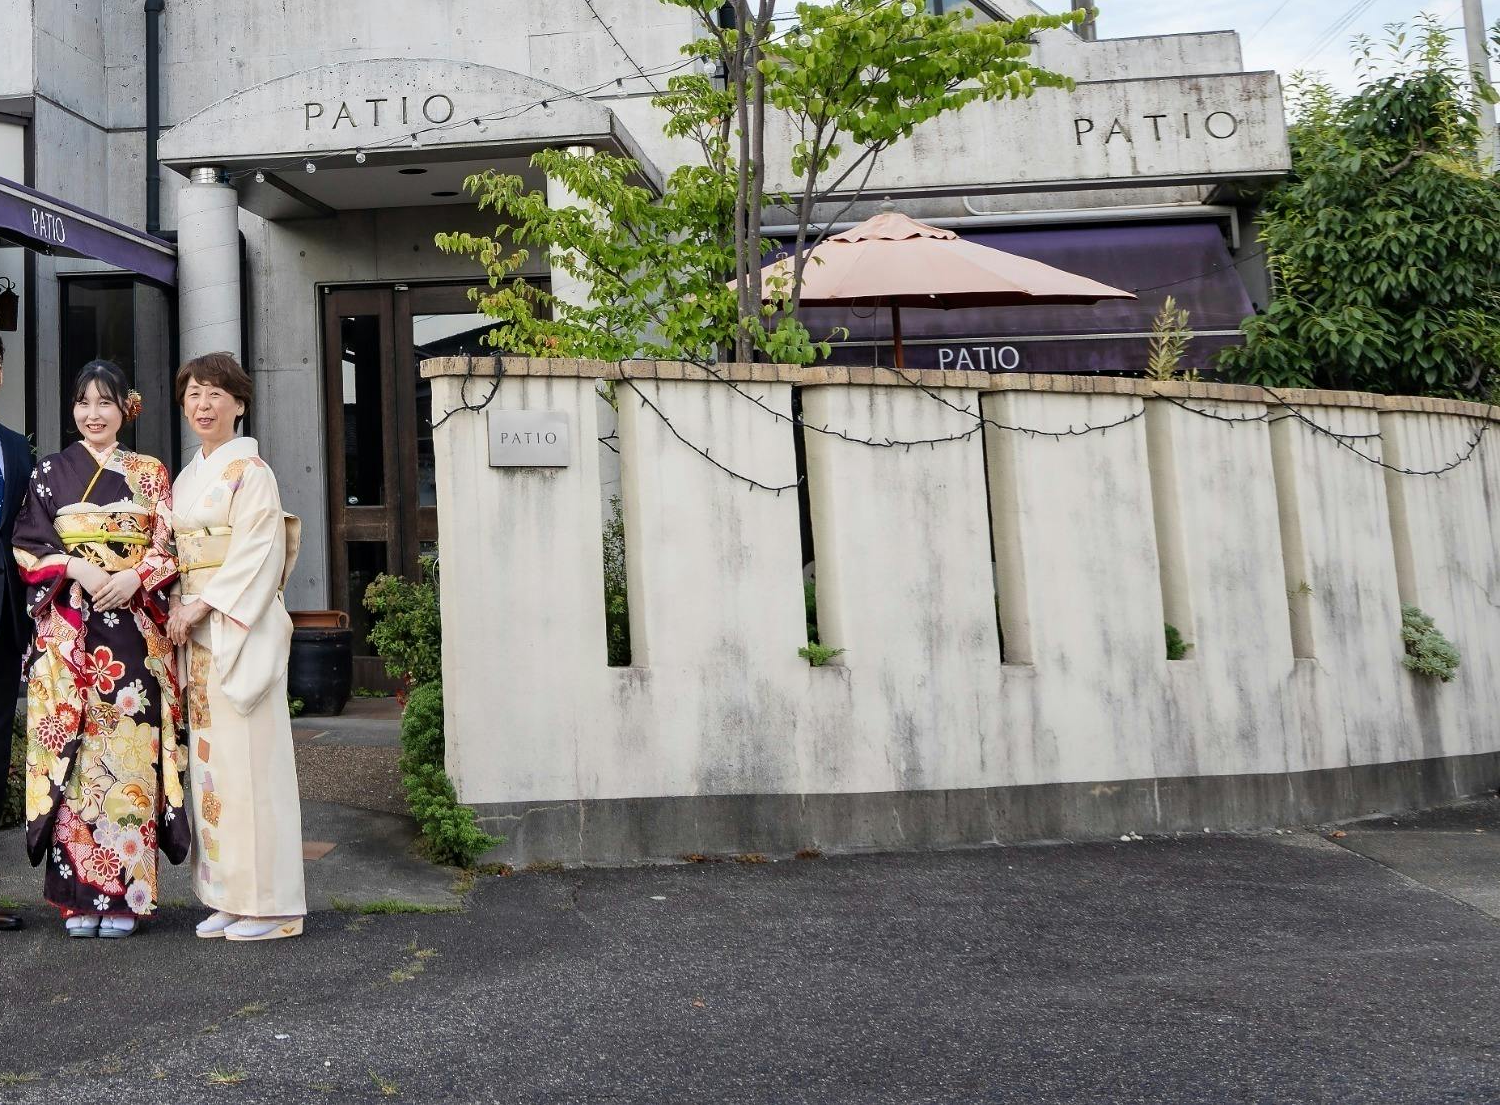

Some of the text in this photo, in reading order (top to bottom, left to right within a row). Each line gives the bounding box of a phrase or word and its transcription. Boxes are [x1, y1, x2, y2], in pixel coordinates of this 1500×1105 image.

[304, 94, 455, 130] PATIO
[1074, 111, 1238, 146] PATIO
[31, 207, 66, 243] PATIO
[938, 345, 1020, 371] PATIO
[501, 431, 557, 445] PATIO
